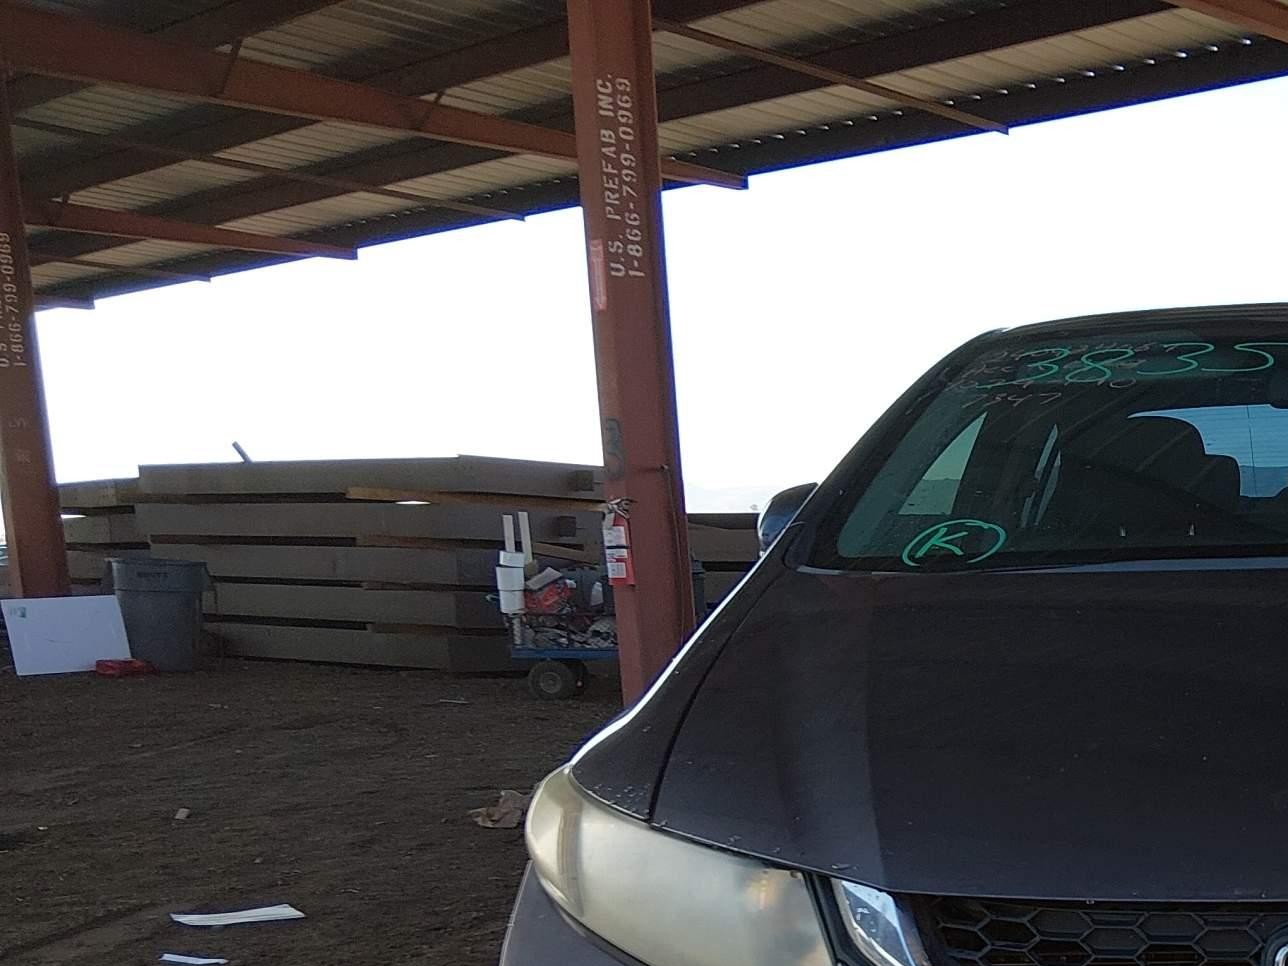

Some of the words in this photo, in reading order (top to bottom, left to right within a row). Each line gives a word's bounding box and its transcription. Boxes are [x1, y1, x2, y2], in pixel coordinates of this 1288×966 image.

[596, 73, 613, 117] INC.
[600, 128, 622, 220] PREFAB
[615, 77, 645, 278] 1-866-799-0969
[608, 234, 626, 277] U.S.
[914, 527, 968, 559] K
